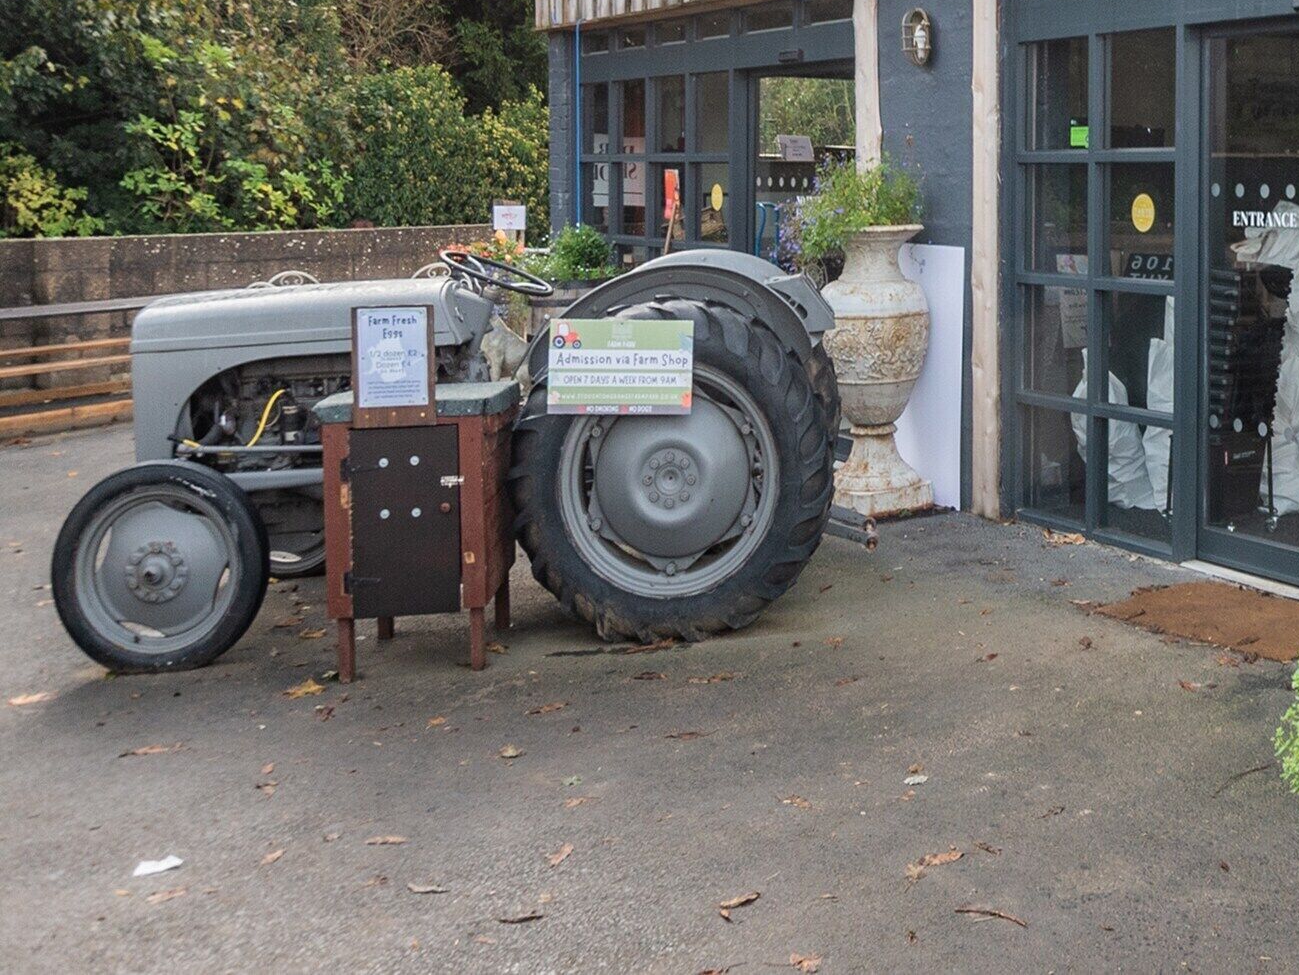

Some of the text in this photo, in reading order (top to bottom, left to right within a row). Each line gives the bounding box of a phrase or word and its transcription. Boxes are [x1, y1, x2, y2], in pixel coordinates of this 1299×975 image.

[1233, 211, 1297, 228] ENTRANCE
[368, 315, 417, 327] Farm Fresh
[382, 328, 403, 339] Eggs
[556, 352, 688, 368] Admission via Farm Shop
[563, 375, 582, 385] OPEN
[591, 375, 610, 385] DAYS
[619, 375, 638, 385] WEEK
[639, 375, 658, 385] FROM
